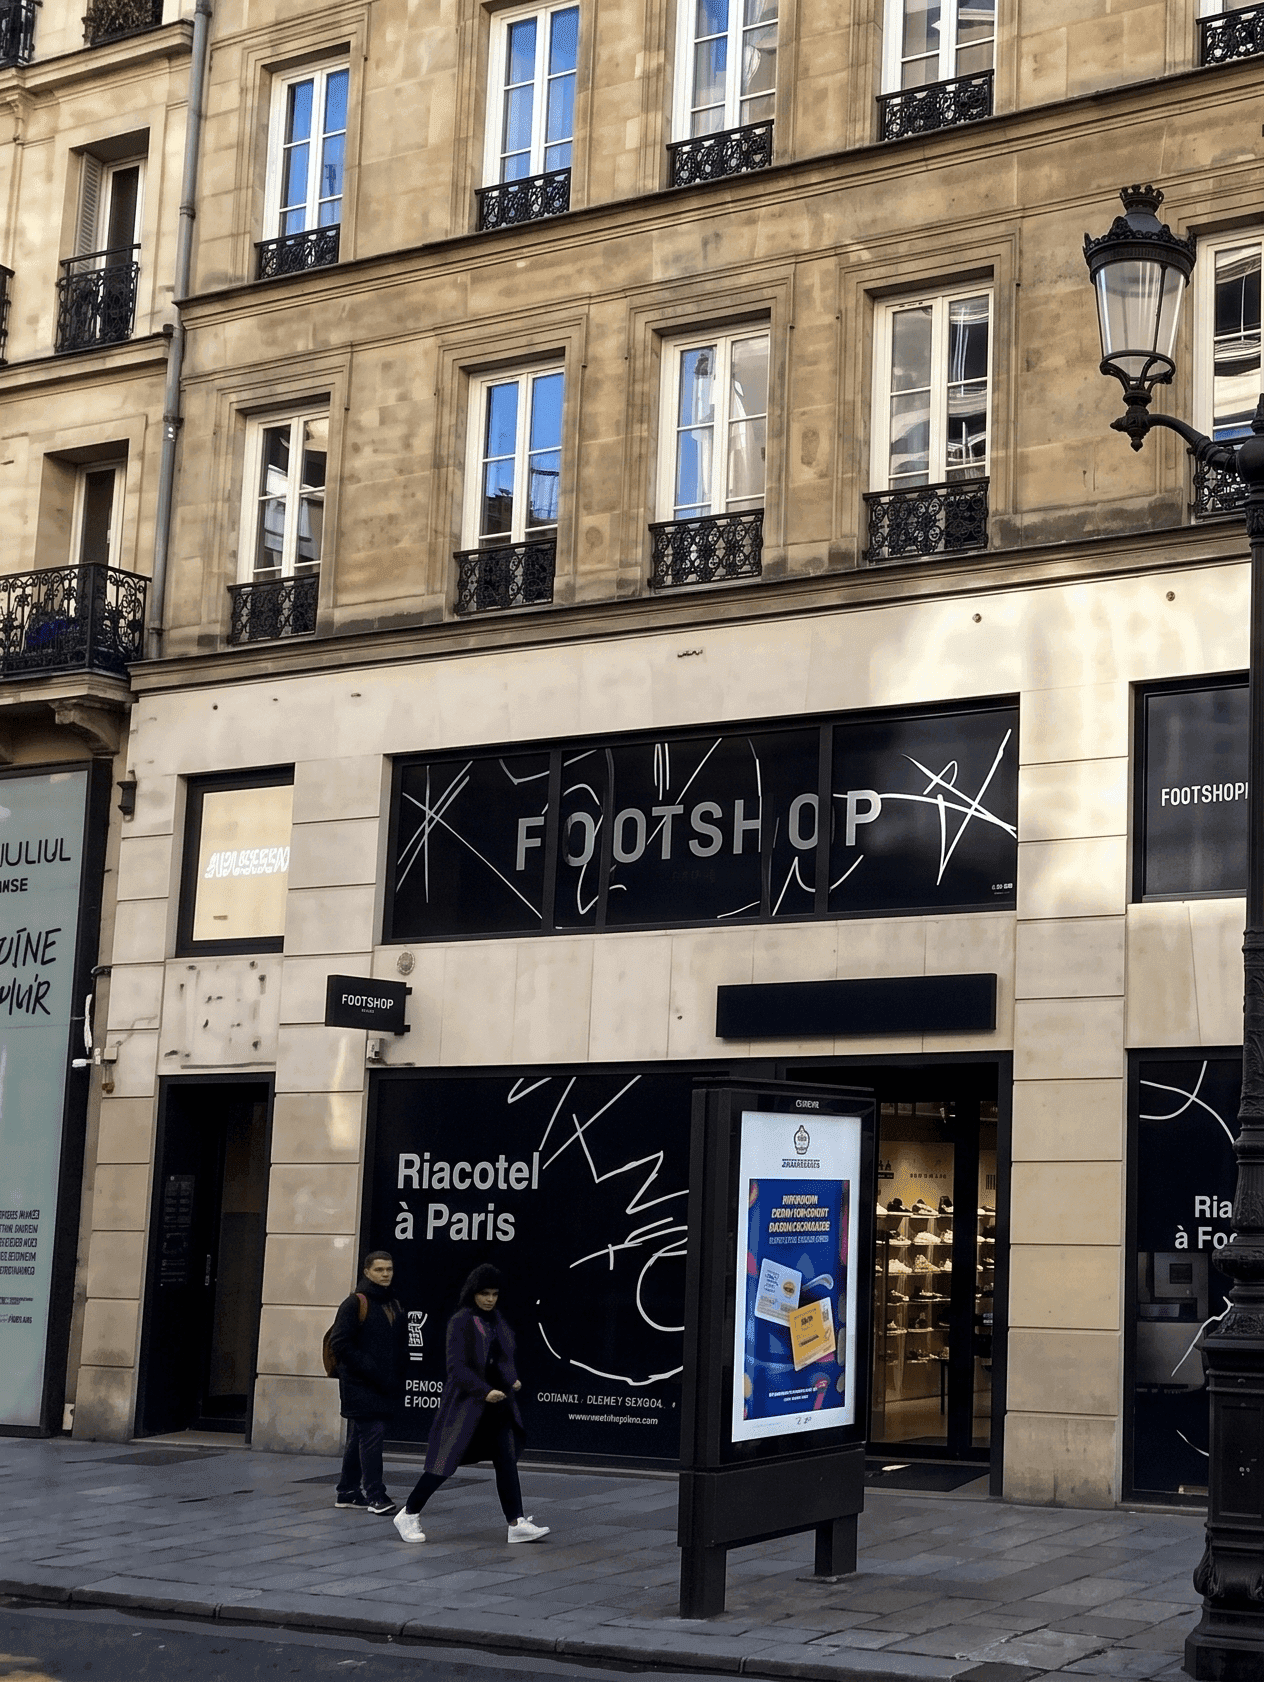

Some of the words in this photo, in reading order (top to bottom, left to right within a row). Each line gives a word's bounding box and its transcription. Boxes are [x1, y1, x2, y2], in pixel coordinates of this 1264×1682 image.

[515, 788, 882, 872] FOOTSHOP
[341, 994, 394, 1010] FOOTSHOP
[397, 1151, 540, 1190] Riacotel
[394, 1201, 414, 1240] à
[426, 1202, 515, 1241] Paris
[1174, 1224, 1189, 1250] à
[404, 1395, 412, 1407] E
